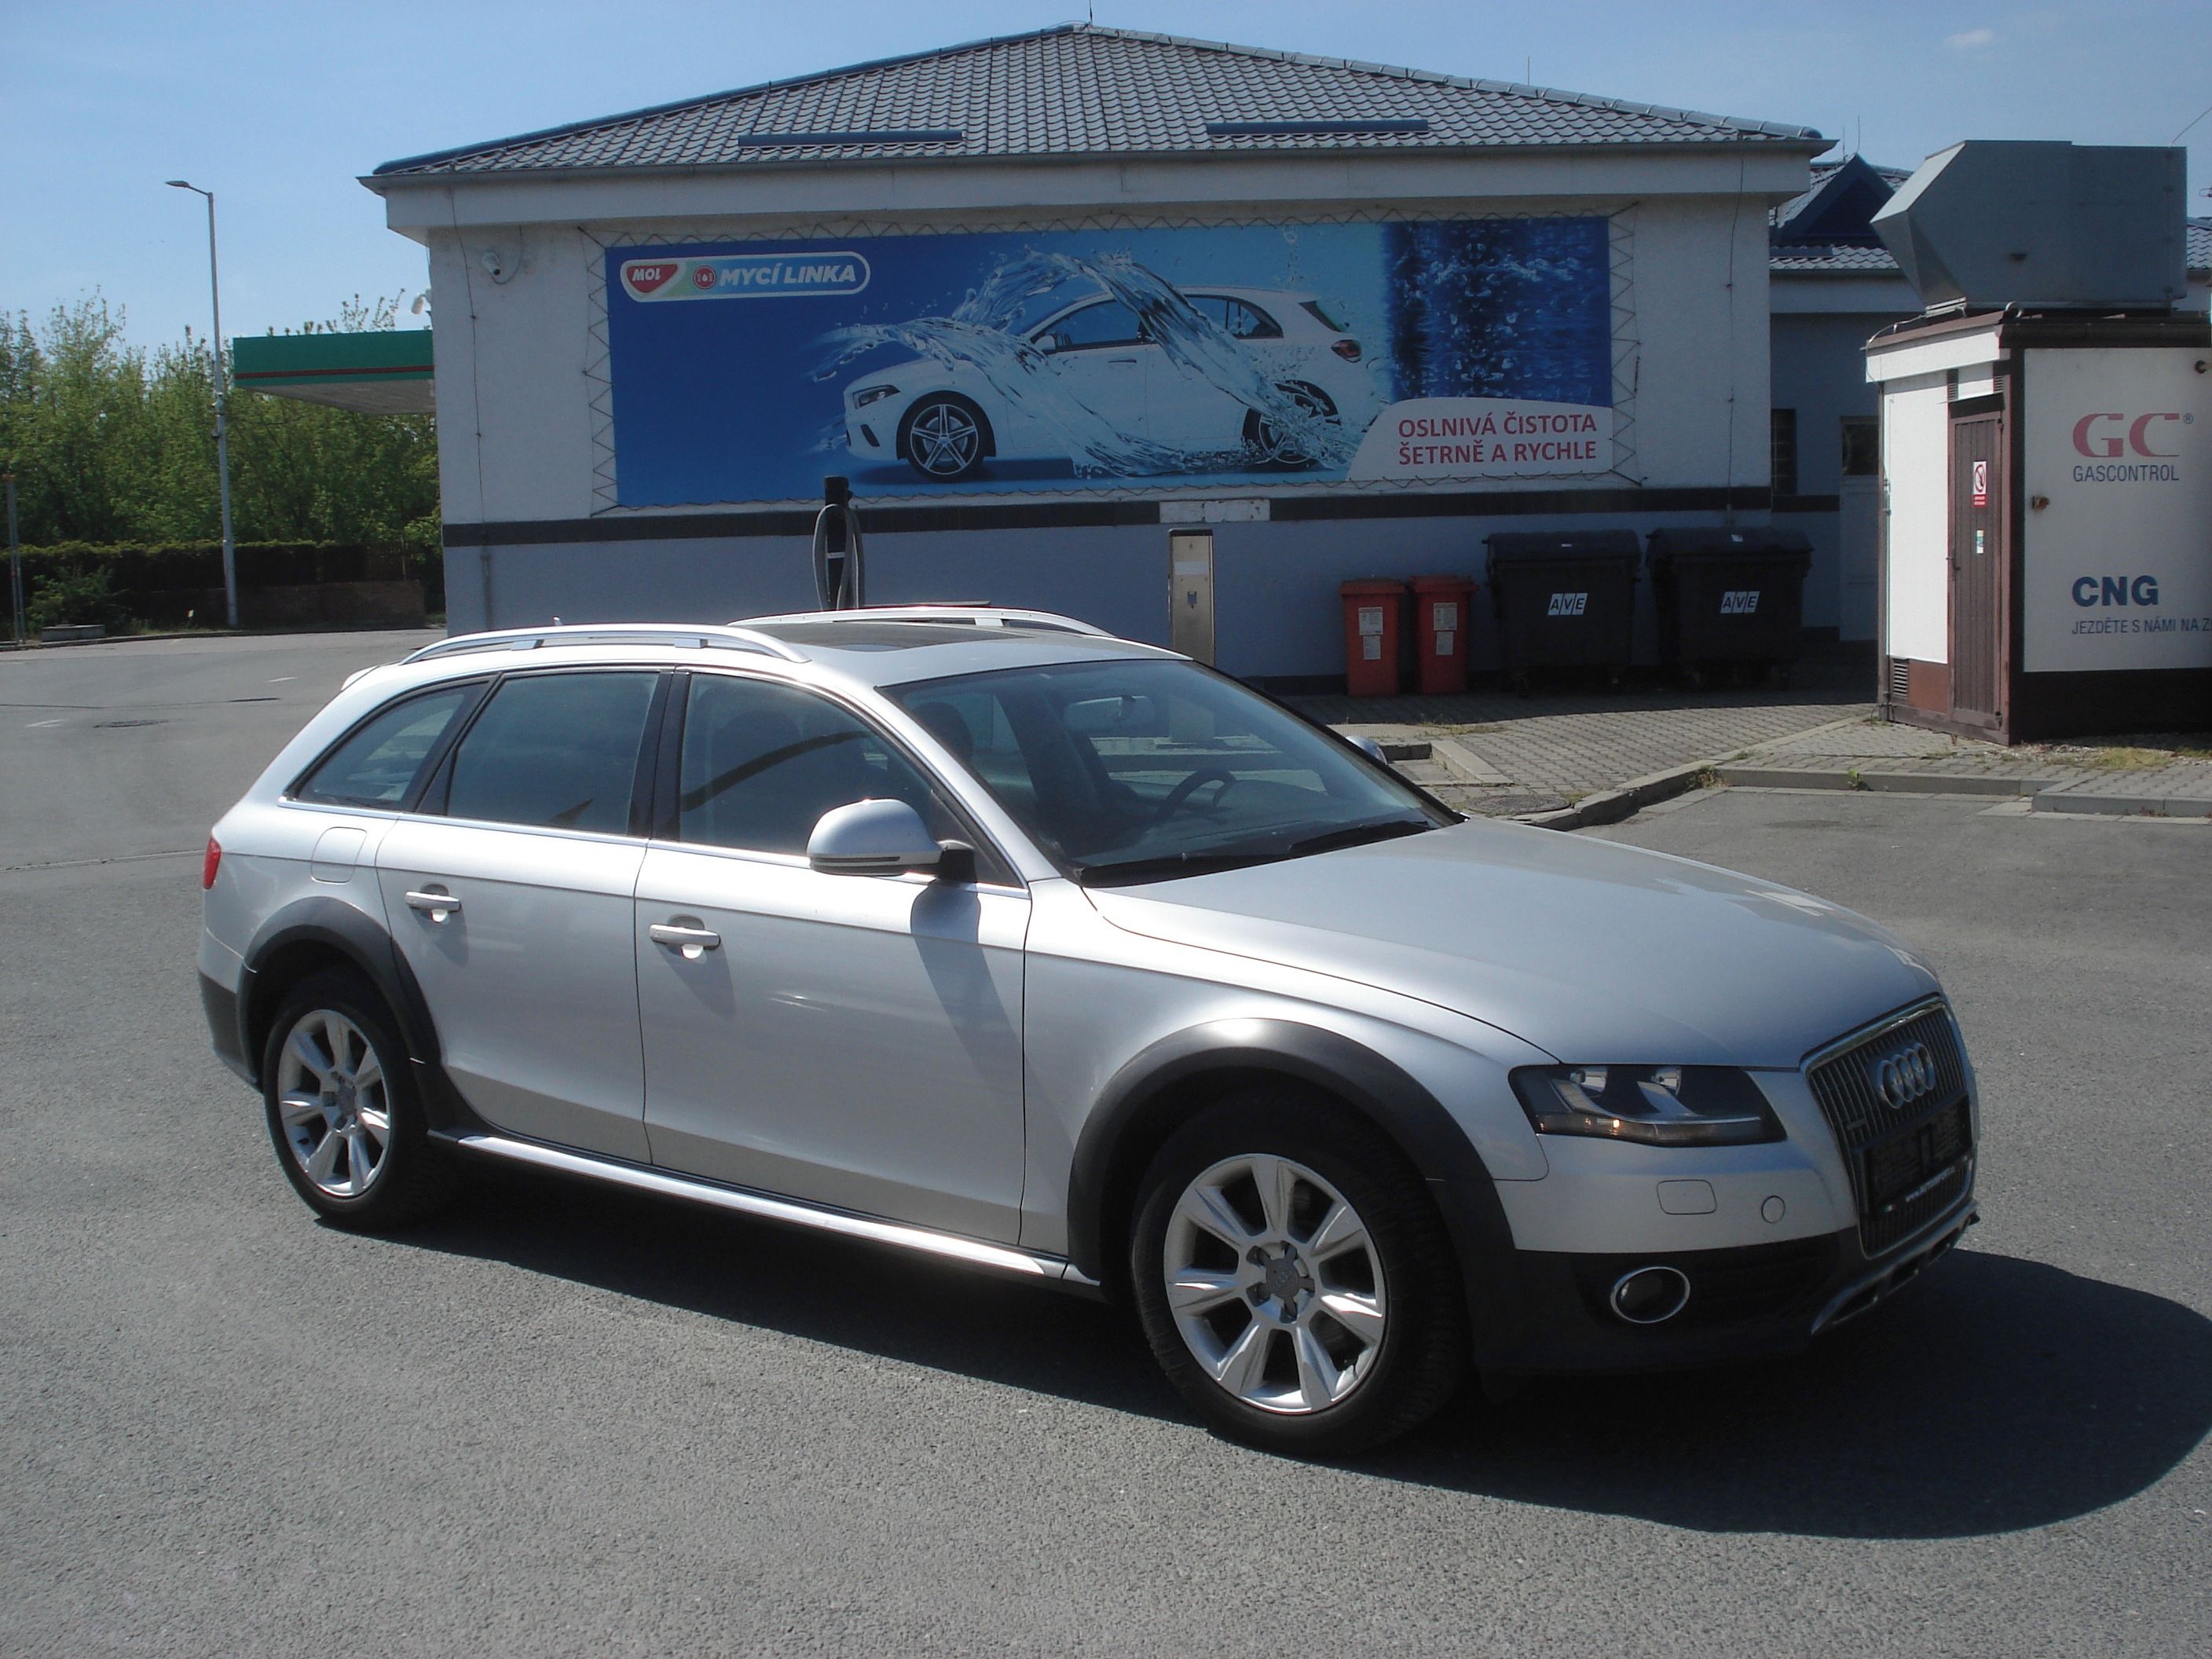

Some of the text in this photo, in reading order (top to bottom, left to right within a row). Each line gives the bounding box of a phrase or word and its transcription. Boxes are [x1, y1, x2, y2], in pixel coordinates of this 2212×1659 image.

[632, 268, 661, 281] MOL
[720, 262, 856, 286] MYCÍ LINKA
[1398, 411, 1597, 438] OSLNIVÁ ČISTOTA
[2072, 413, 2180, 457] GC
[1399, 439, 1597, 465] ŠETRNĚ A RYCHLE
[2072, 464, 2179, 482] GASCONTROL
[2072, 575, 2159, 607] CNG
[1549, 596, 1586, 612] AVE
[1722, 595, 1757, 610] AVE
[2071, 617, 2129, 635] JEZDĚTE
[2132, 619, 2141, 633] S
[2144, 616, 2176, 633] NÁMI
[2181, 618, 2199, 632] NA
